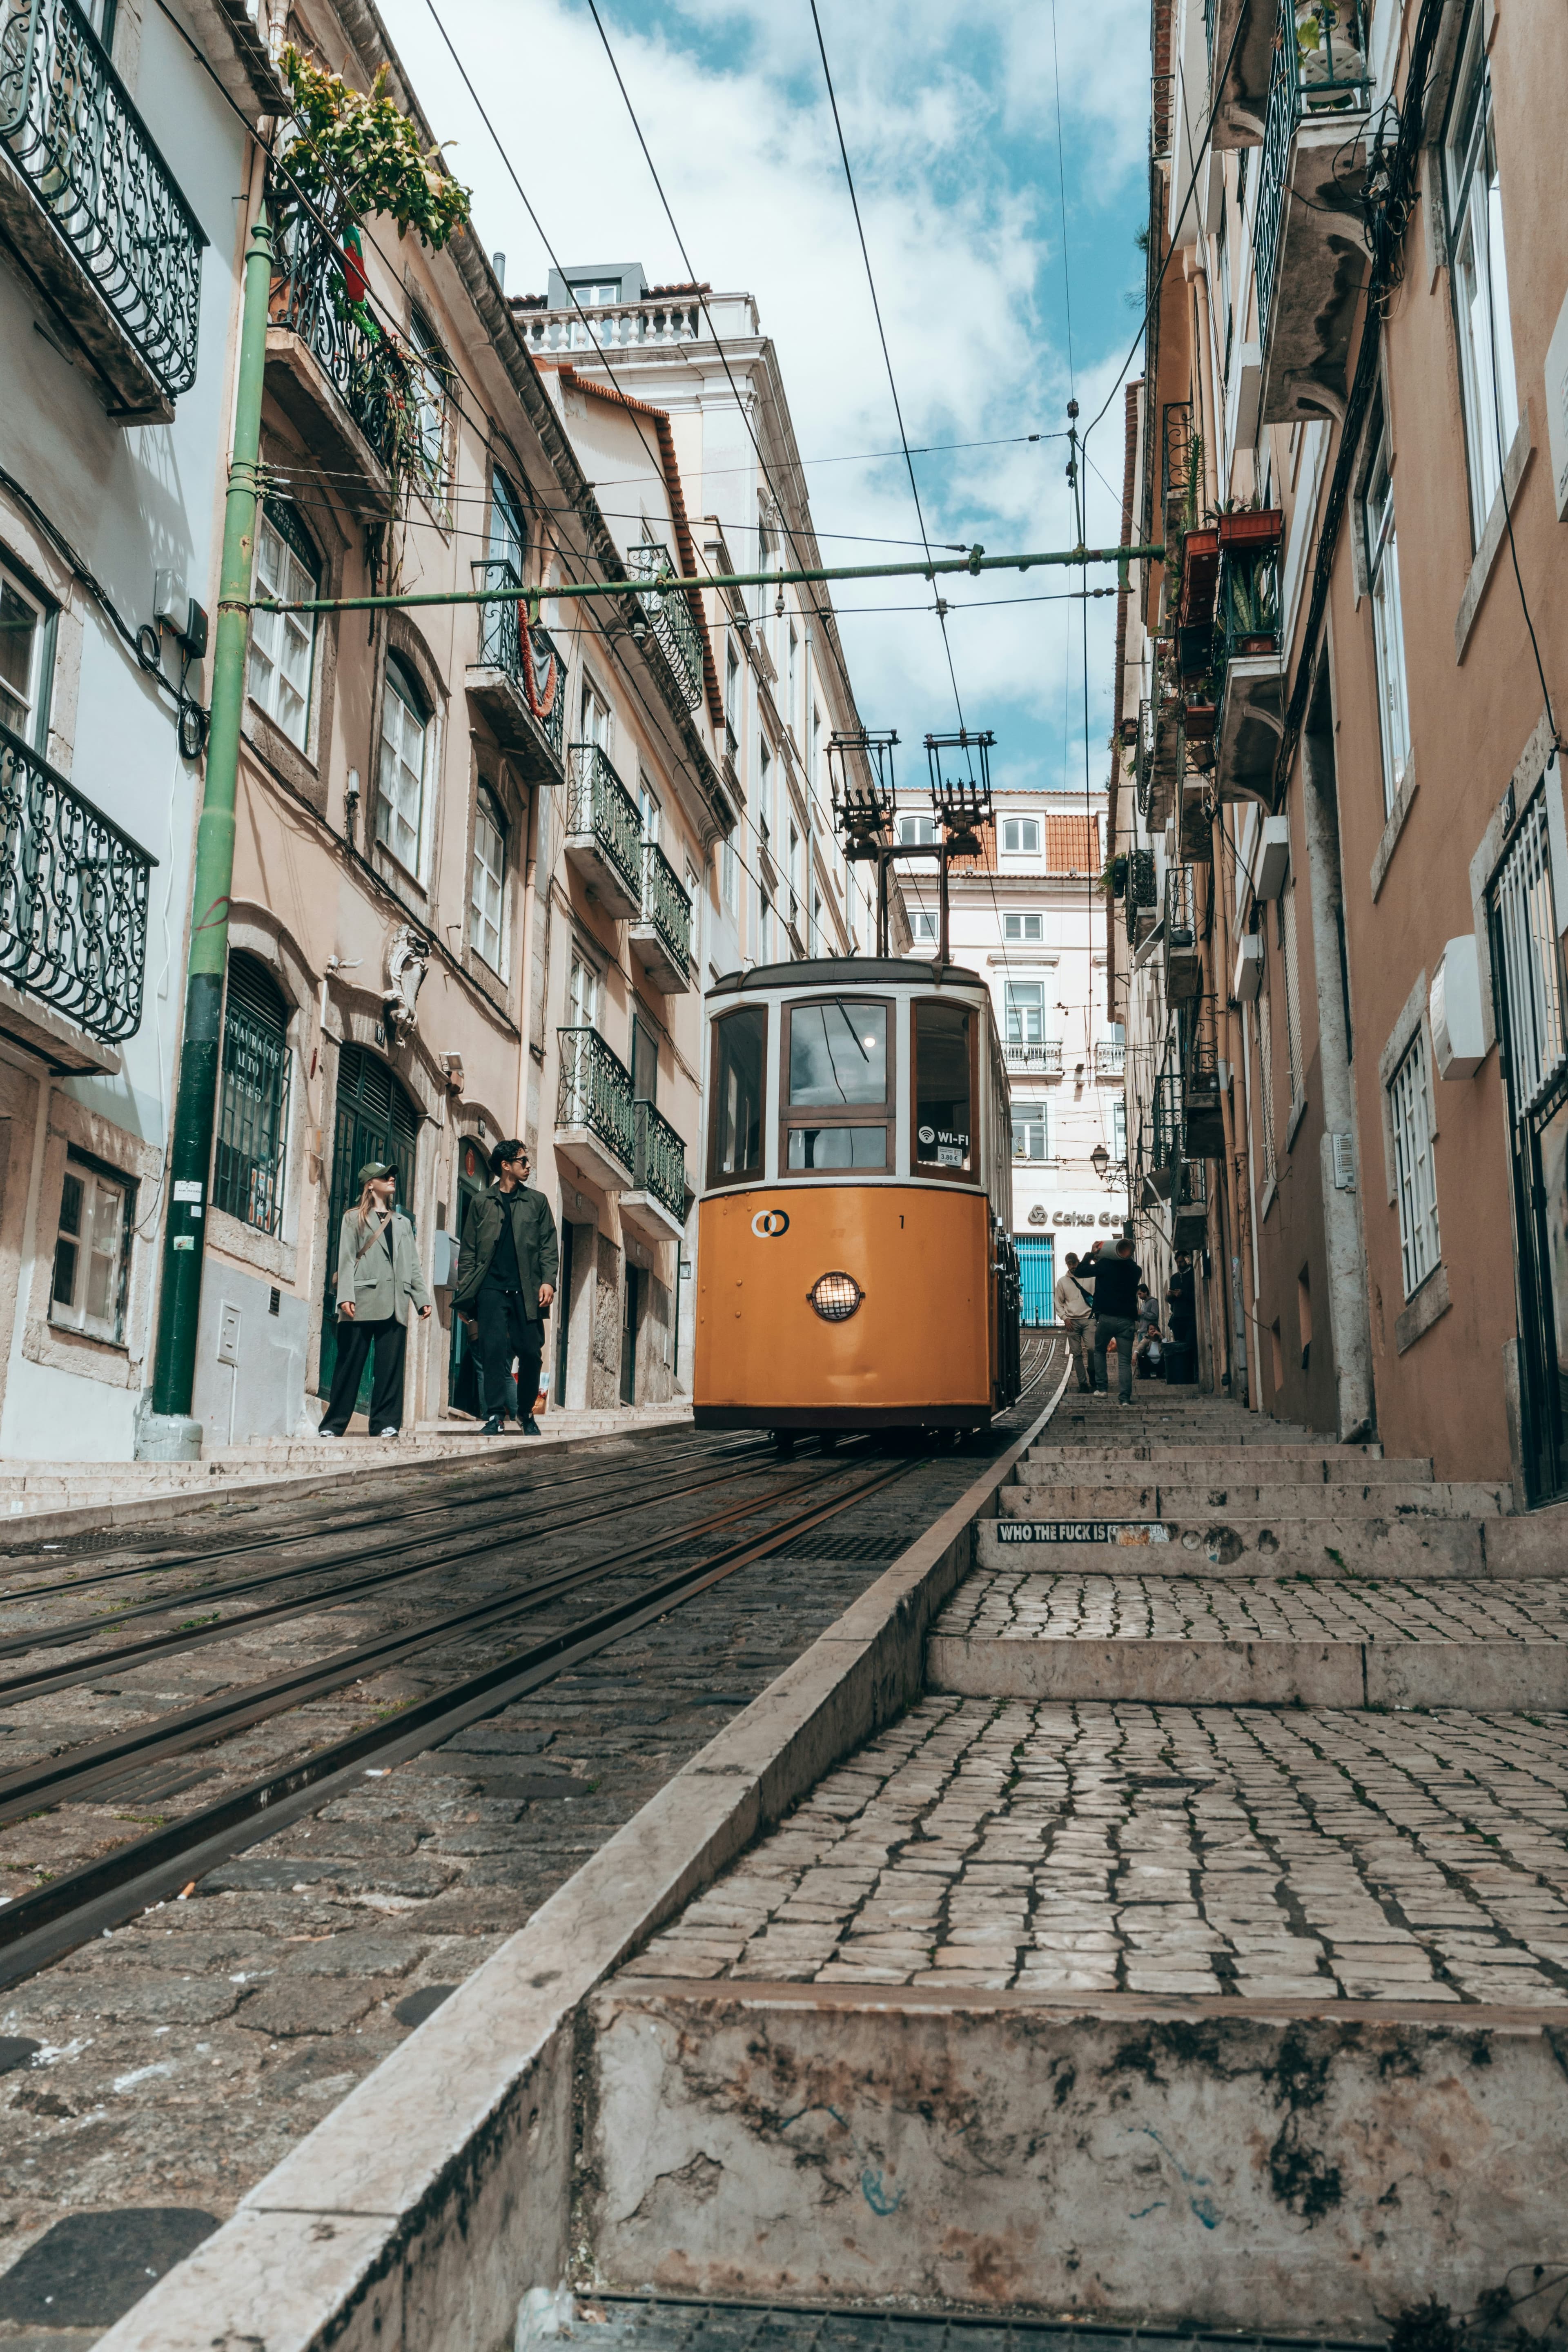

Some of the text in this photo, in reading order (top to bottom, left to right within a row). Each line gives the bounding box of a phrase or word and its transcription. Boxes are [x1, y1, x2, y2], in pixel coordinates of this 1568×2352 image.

[378, 1025, 384, 1043] 61
[938, 1131, 969, 1146] WI-FI
[899, 1215, 904, 1229] 1
[1052, 1211, 1095, 1227] Caixa
[1000, 1524, 1105, 1541] WHO THE FUCK IS
